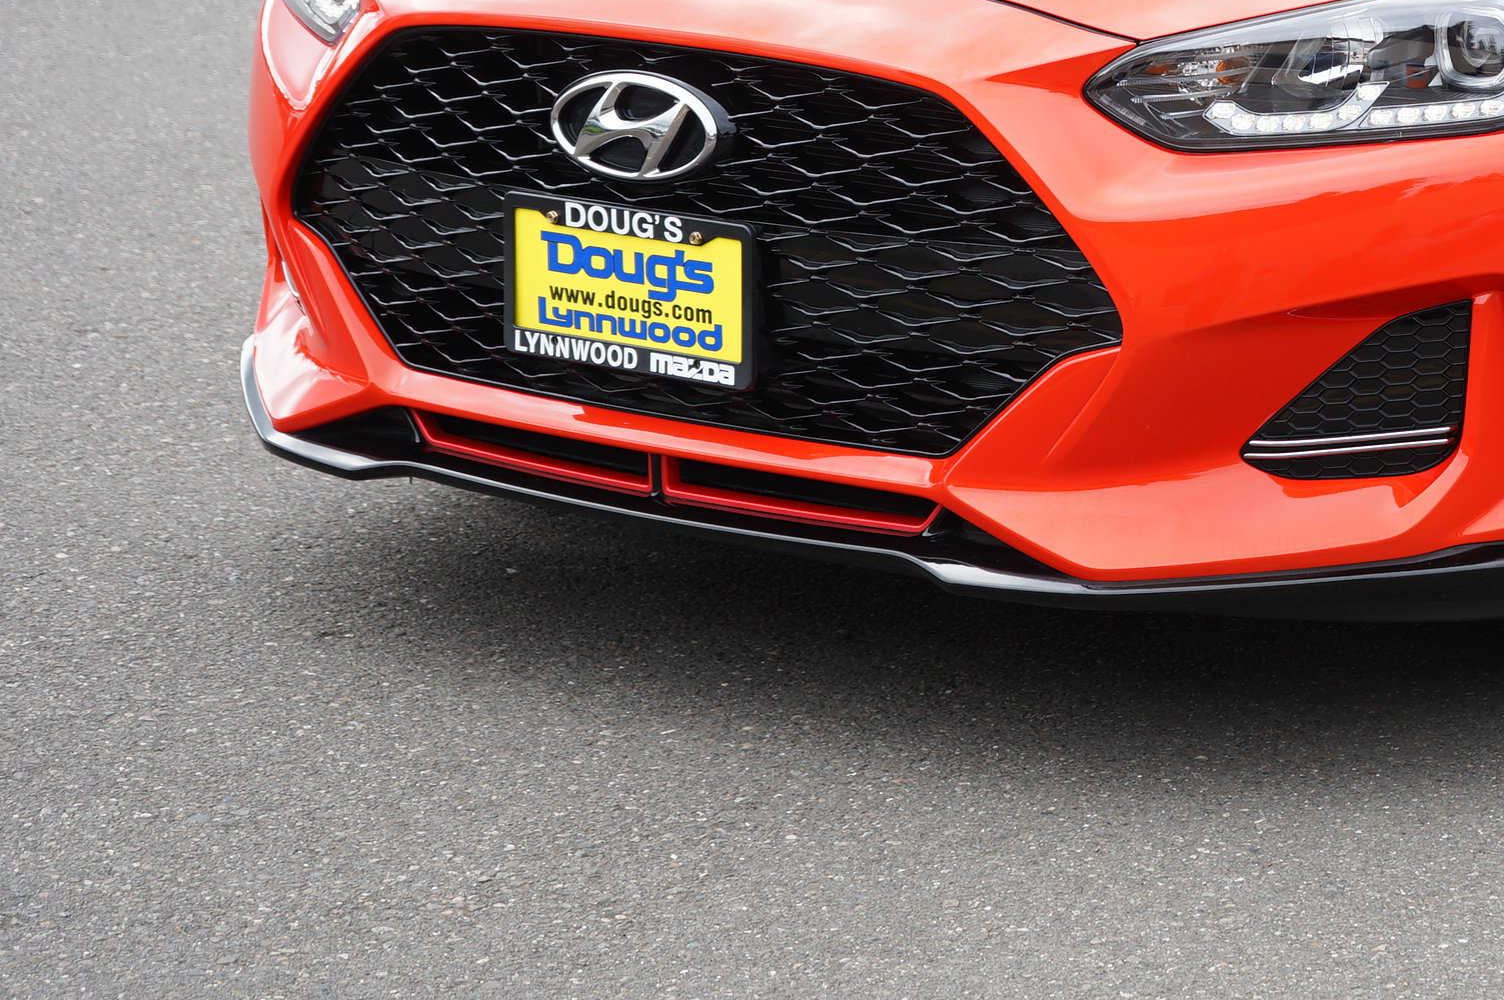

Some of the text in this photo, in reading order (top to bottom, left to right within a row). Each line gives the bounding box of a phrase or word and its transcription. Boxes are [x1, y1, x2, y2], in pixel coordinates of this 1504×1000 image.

[565, 202, 683, 243] DOUG'S
[538, 296, 723, 351] Lynnwood
[549, 285, 713, 324] www.dougs.com
[514, 329, 638, 369] LYNNWOOD
